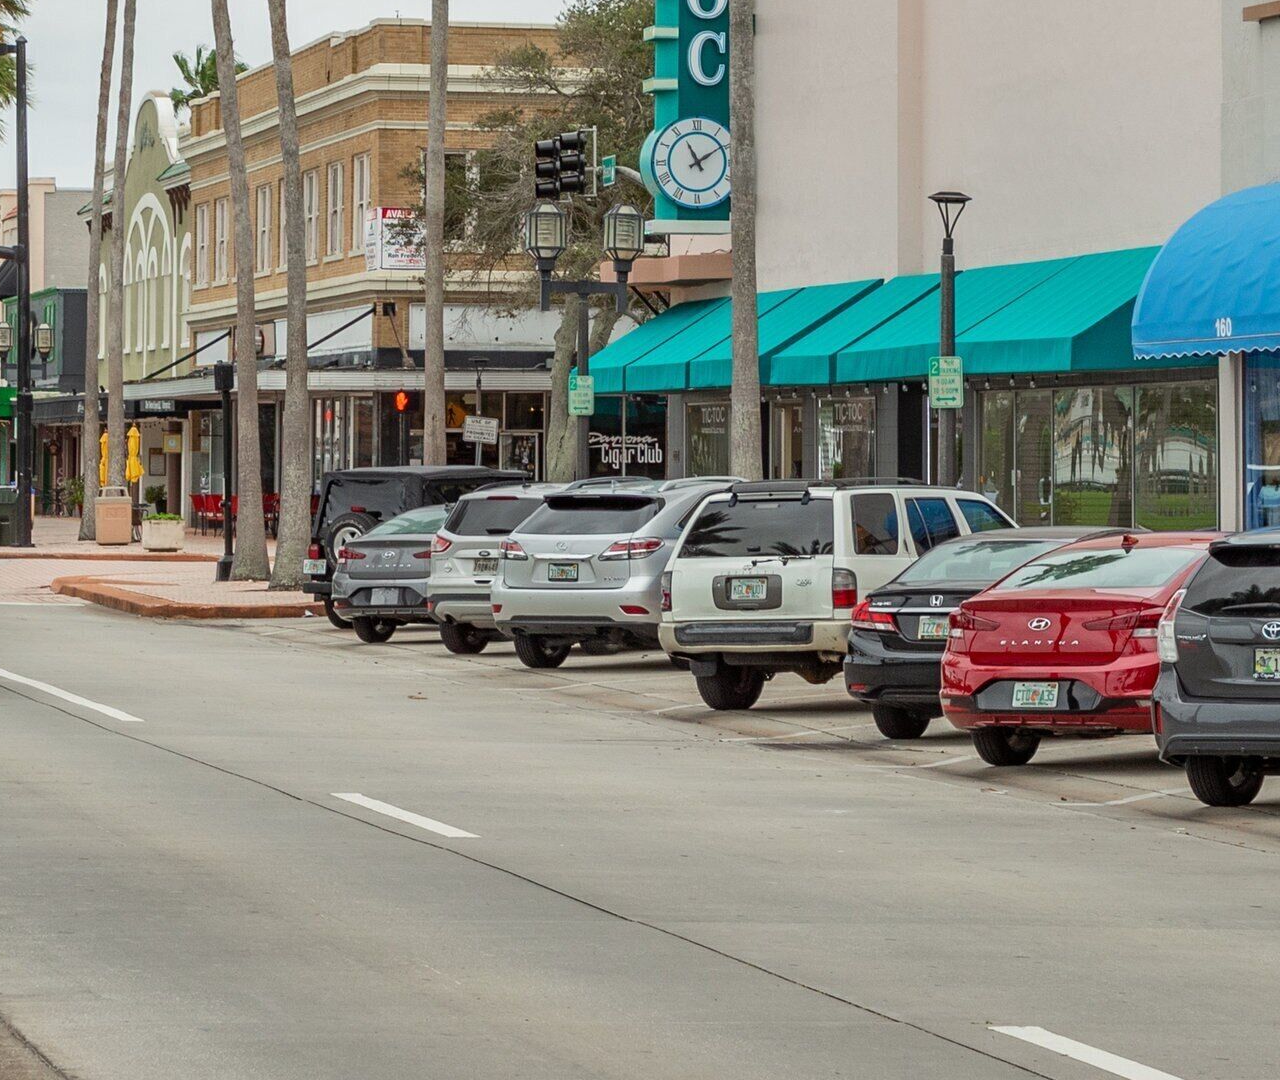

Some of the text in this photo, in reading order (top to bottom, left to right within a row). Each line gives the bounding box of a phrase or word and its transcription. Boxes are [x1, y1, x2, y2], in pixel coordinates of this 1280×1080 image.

[1215, 317, 1232, 337] 160
[931, 361, 939, 374] 2
[588, 431, 658, 448] Daytona
[601, 442, 663, 469] Cigar Club
